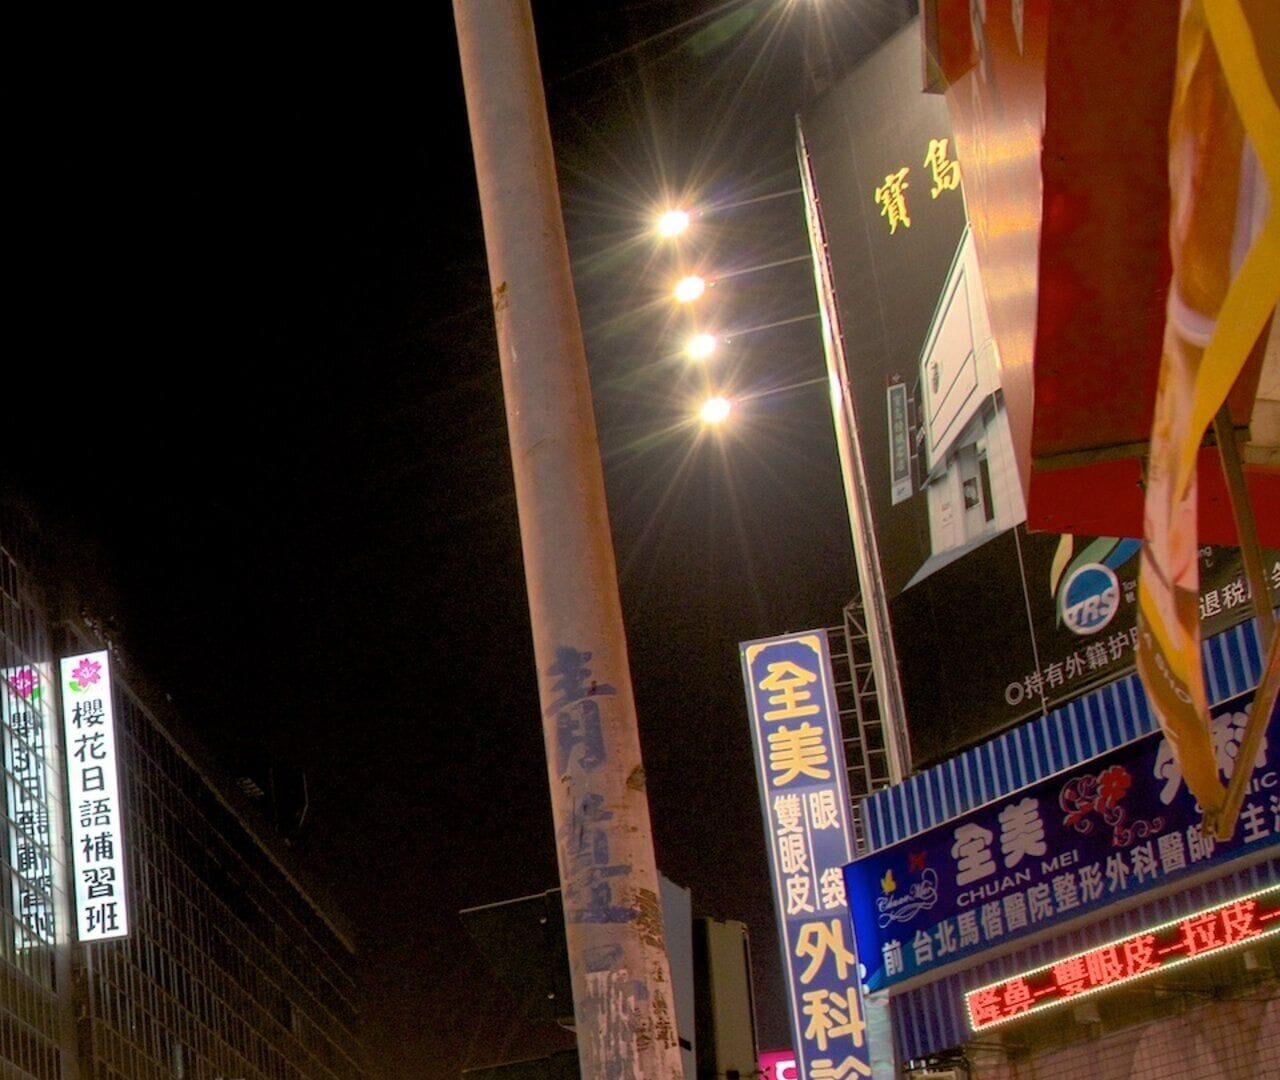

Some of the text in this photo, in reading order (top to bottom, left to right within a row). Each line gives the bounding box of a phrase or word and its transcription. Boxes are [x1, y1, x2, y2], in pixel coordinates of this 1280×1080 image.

[875, 138, 962, 235] 寶島
[1069, 587, 1116, 629] TRS
[758, 661, 831, 787] 全美
[71, 698, 119, 934] 櫻花日語補習班
[774, 794, 814, 915] 雙眼皮
[950, 797, 1048, 887] 全美
[956, 849, 1079, 909] CHUAN MEI
[882, 941, 903, 977] 前
